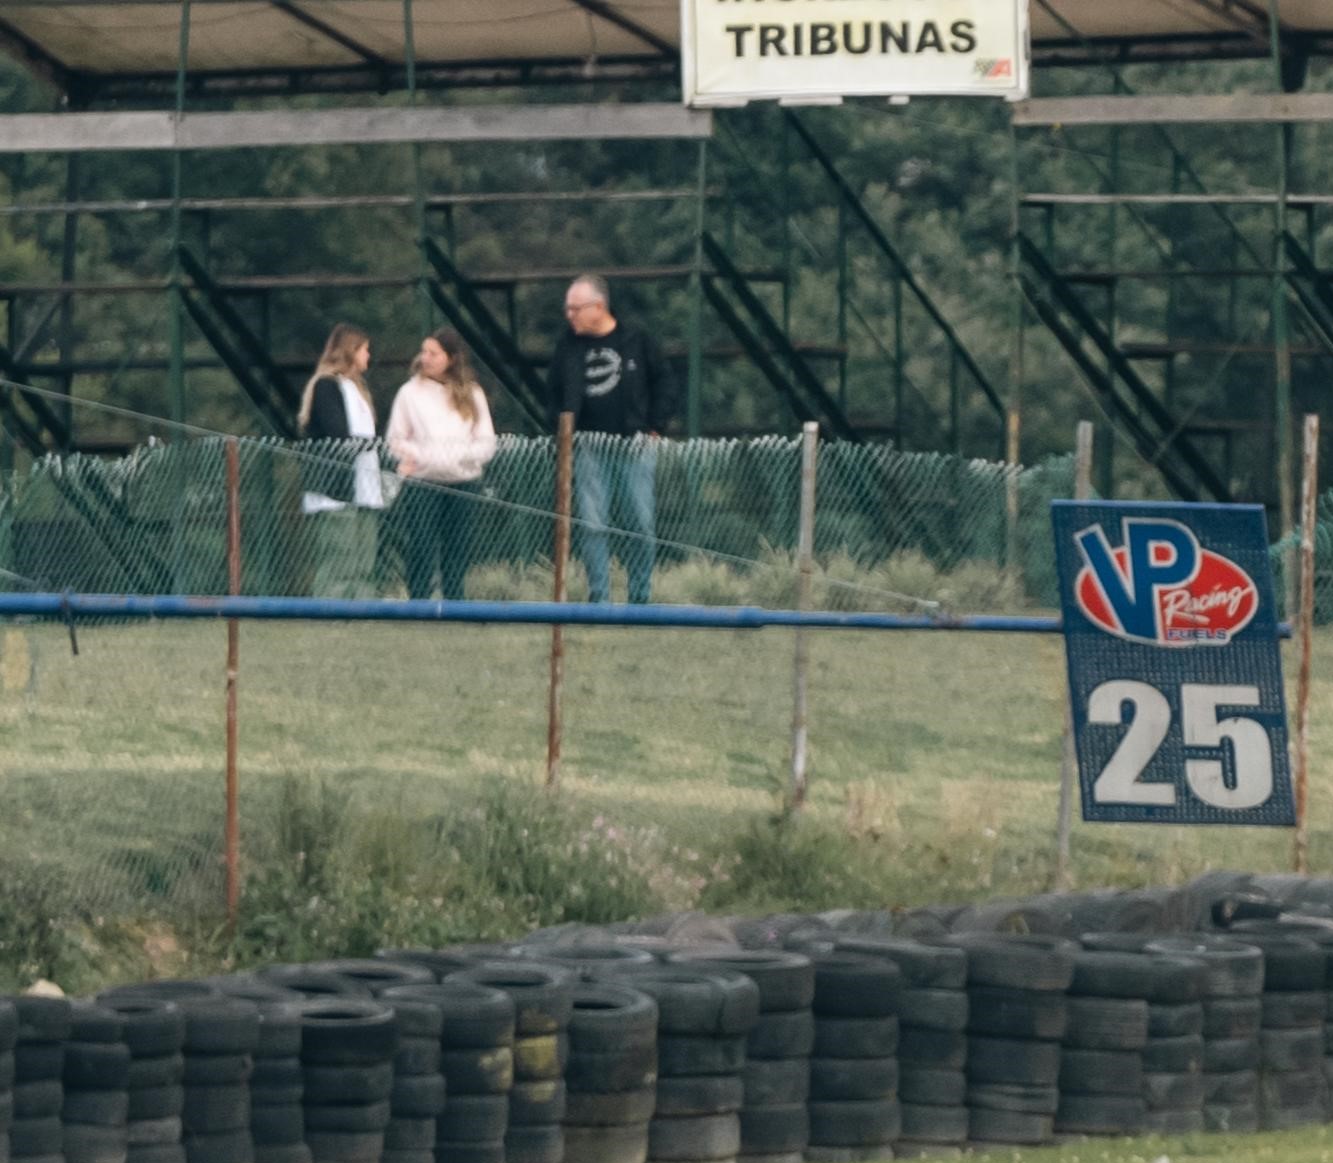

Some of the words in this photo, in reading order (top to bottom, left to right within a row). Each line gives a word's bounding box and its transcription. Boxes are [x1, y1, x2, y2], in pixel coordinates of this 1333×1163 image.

[725, 20, 978, 58] TRIBUNAS
[1074, 517, 1201, 642] VP
[1163, 584, 1253, 627] Racing
[1168, 628, 1227, 640] FUELS
[1087, 679, 1274, 810] 25
